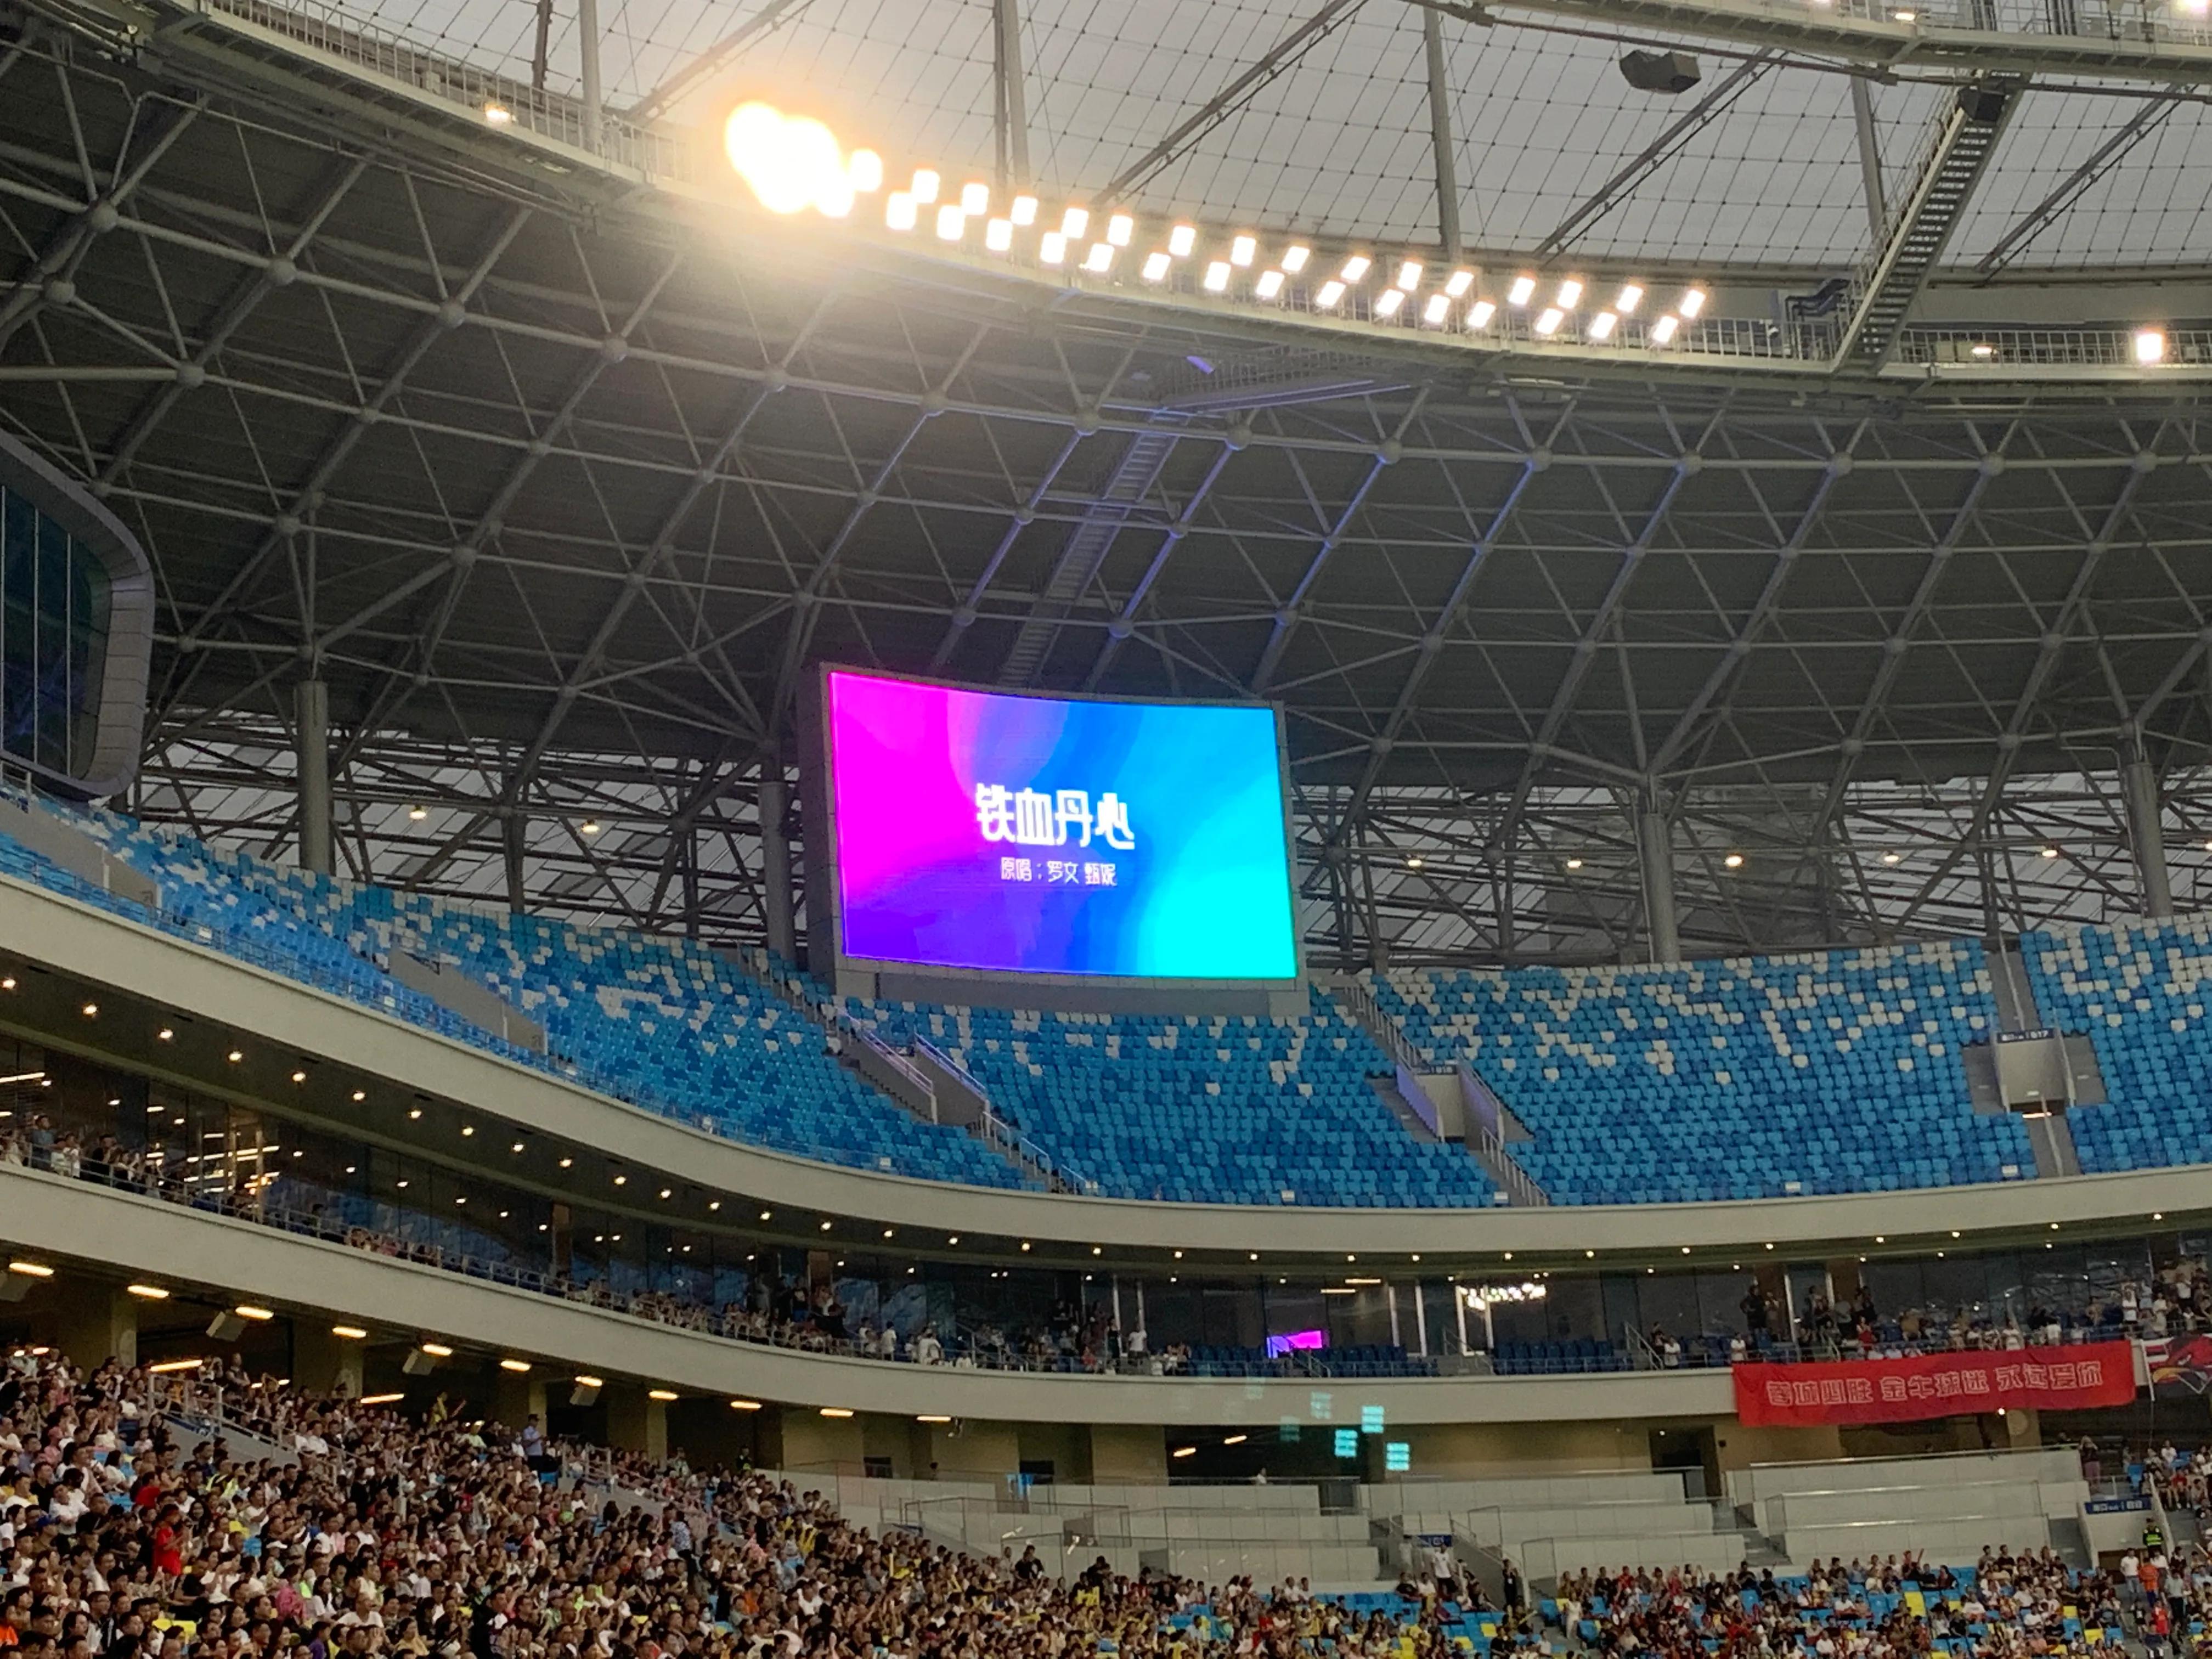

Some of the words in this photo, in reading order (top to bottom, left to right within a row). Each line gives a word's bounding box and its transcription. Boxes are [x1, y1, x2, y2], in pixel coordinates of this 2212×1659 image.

[975, 783, 1135, 850] 铁血丹心
[1994, 1361, 2103, 1392] 永远爱你
